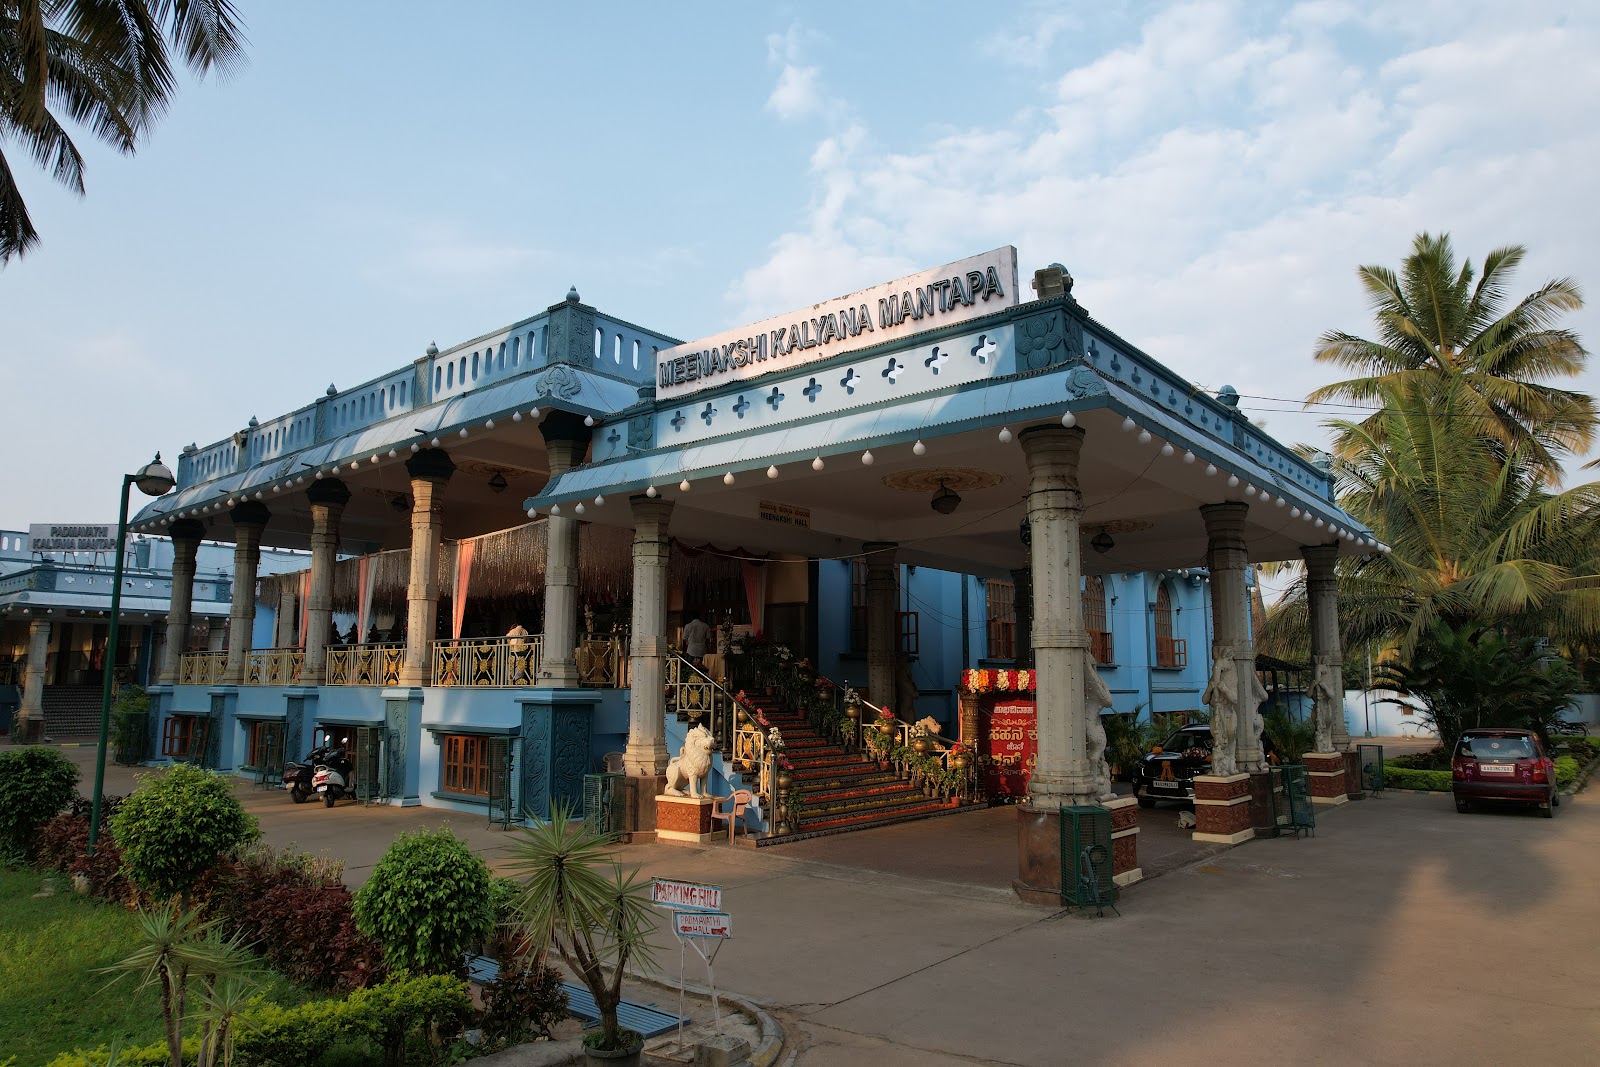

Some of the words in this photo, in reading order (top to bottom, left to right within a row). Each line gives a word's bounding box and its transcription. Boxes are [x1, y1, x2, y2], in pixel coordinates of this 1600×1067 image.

[659, 333, 768, 388] MEENAKSHI
[770, 303, 874, 358] KALYANA
[878, 265, 1004, 329] MANTAPA
[51, 526, 108, 538] PADMAVATHI
[33, 538, 75, 549] KALYANA
[656, 882, 696, 904] PARKING
[693, 926, 710, 934] HALL
